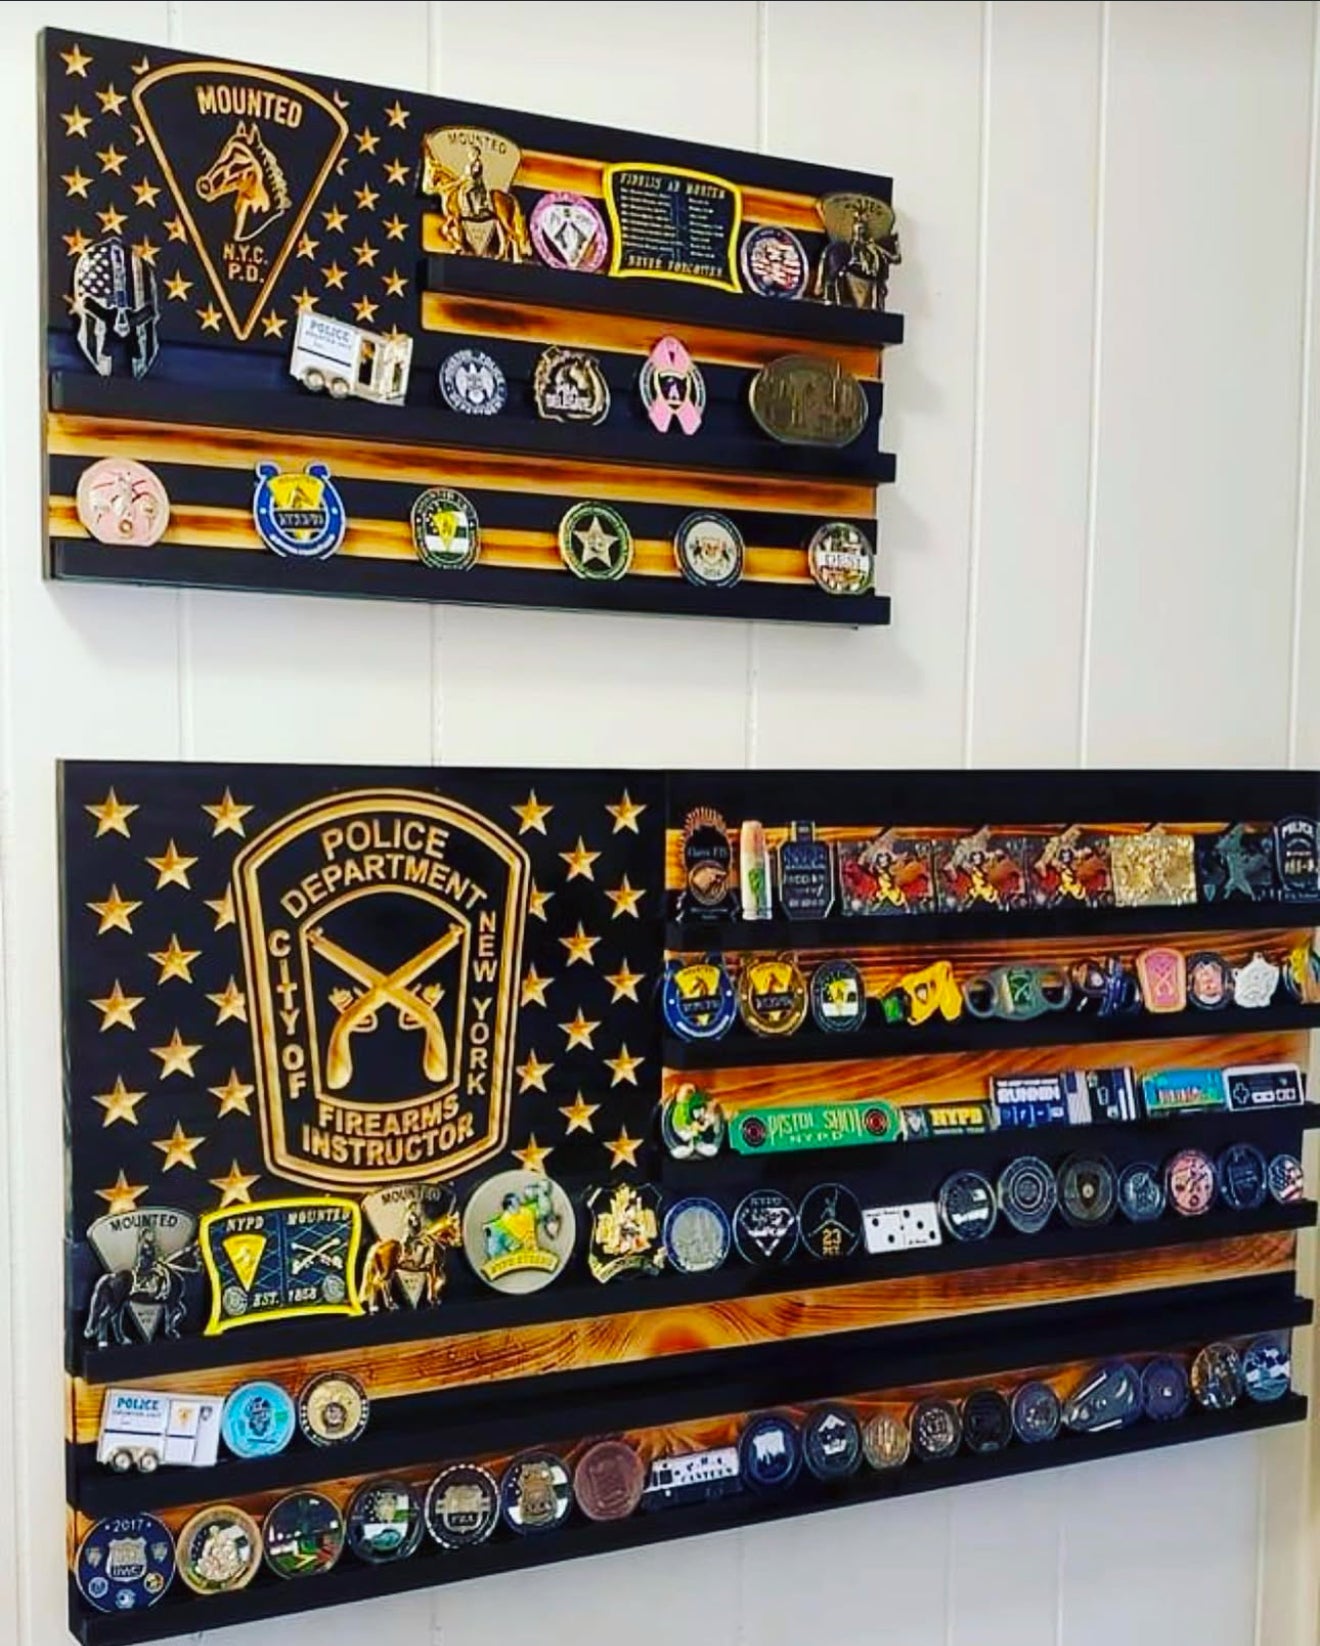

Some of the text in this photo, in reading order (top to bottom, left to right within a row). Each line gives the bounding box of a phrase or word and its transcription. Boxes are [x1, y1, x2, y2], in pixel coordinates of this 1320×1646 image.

[196, 85, 303, 128] MOUNTED
[447, 132, 507, 155] MOUNTED
[223, 243, 268, 265] N.Y.C.
[228, 262, 265, 283] P.D.
[310, 319, 351, 343] POLICE
[321, 818, 449, 859] POLICE
[280, 853, 488, 920] DEPARTMENT
[267, 929, 306, 1099] CITY OF
[466, 910, 498, 1096] NEW YORK
[318, 1091, 460, 1137] FIREARMS
[301, 1112, 475, 1166] INSTRUCTOR
[110, 1214, 178, 1231] MOUNTED
[226, 1215, 265, 1232] NYPD
[253, 1291, 280, 1308] EST.
[116, 1397, 160, 1411] POLICE
[113, 1518, 145, 1533] 2017
